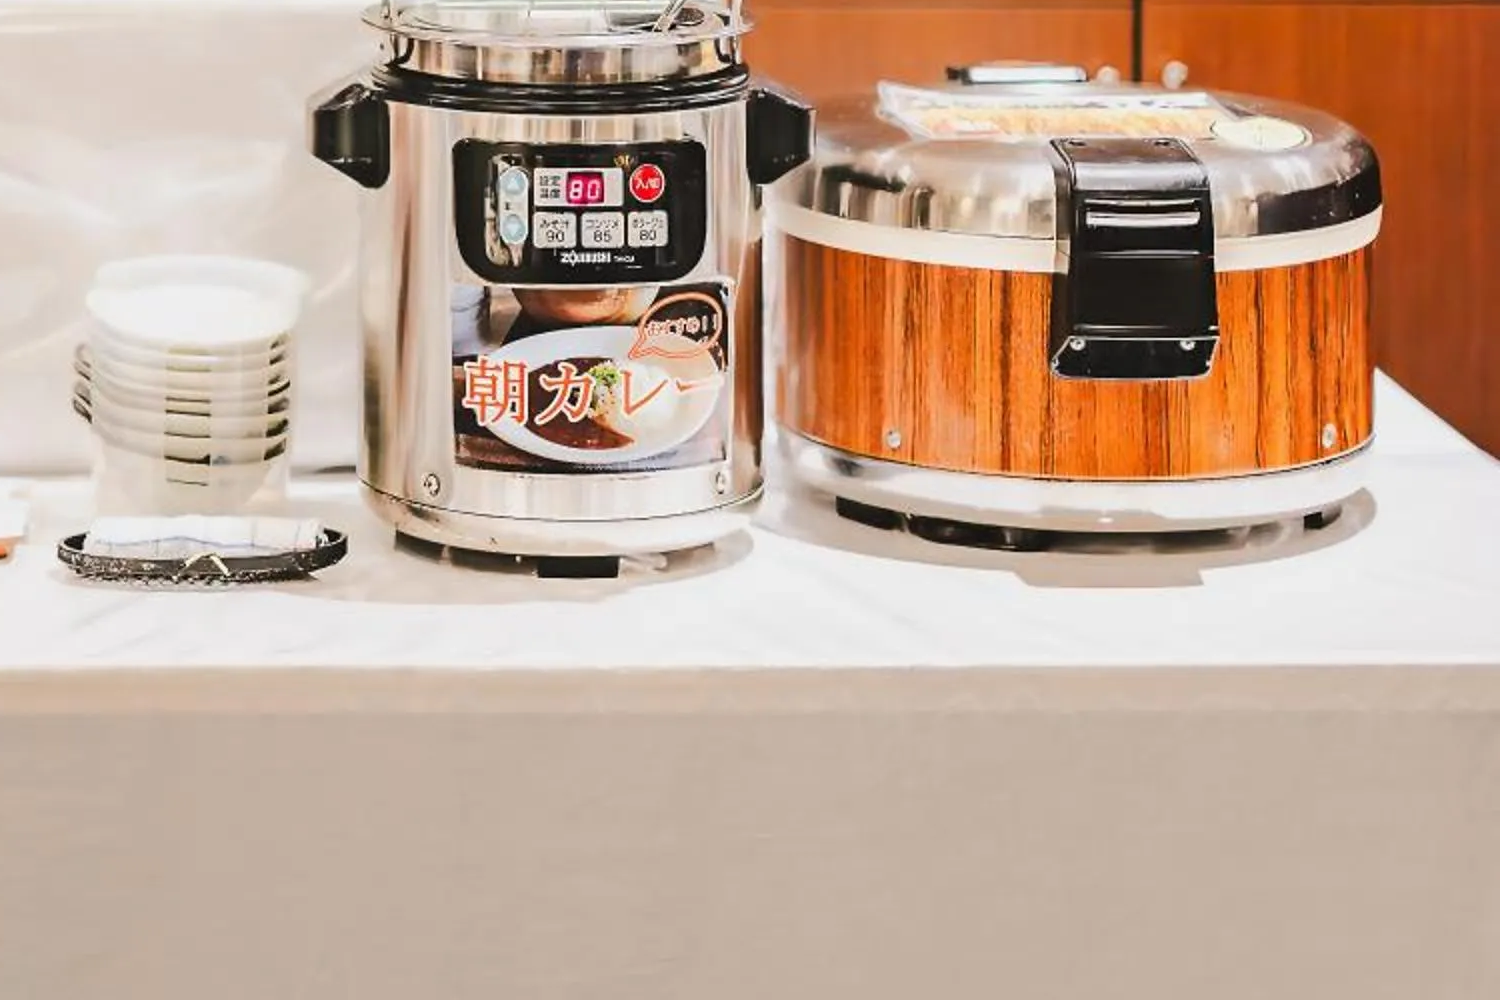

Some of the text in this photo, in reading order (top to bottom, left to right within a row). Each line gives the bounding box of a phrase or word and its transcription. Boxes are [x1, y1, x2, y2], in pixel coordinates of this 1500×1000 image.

[568, 178, 601, 200] 80
[545, 230, 566, 243] 90
[592, 230, 613, 243] 85
[639, 229, 658, 242] 80
[462, 356, 722, 427] 朝カレー
